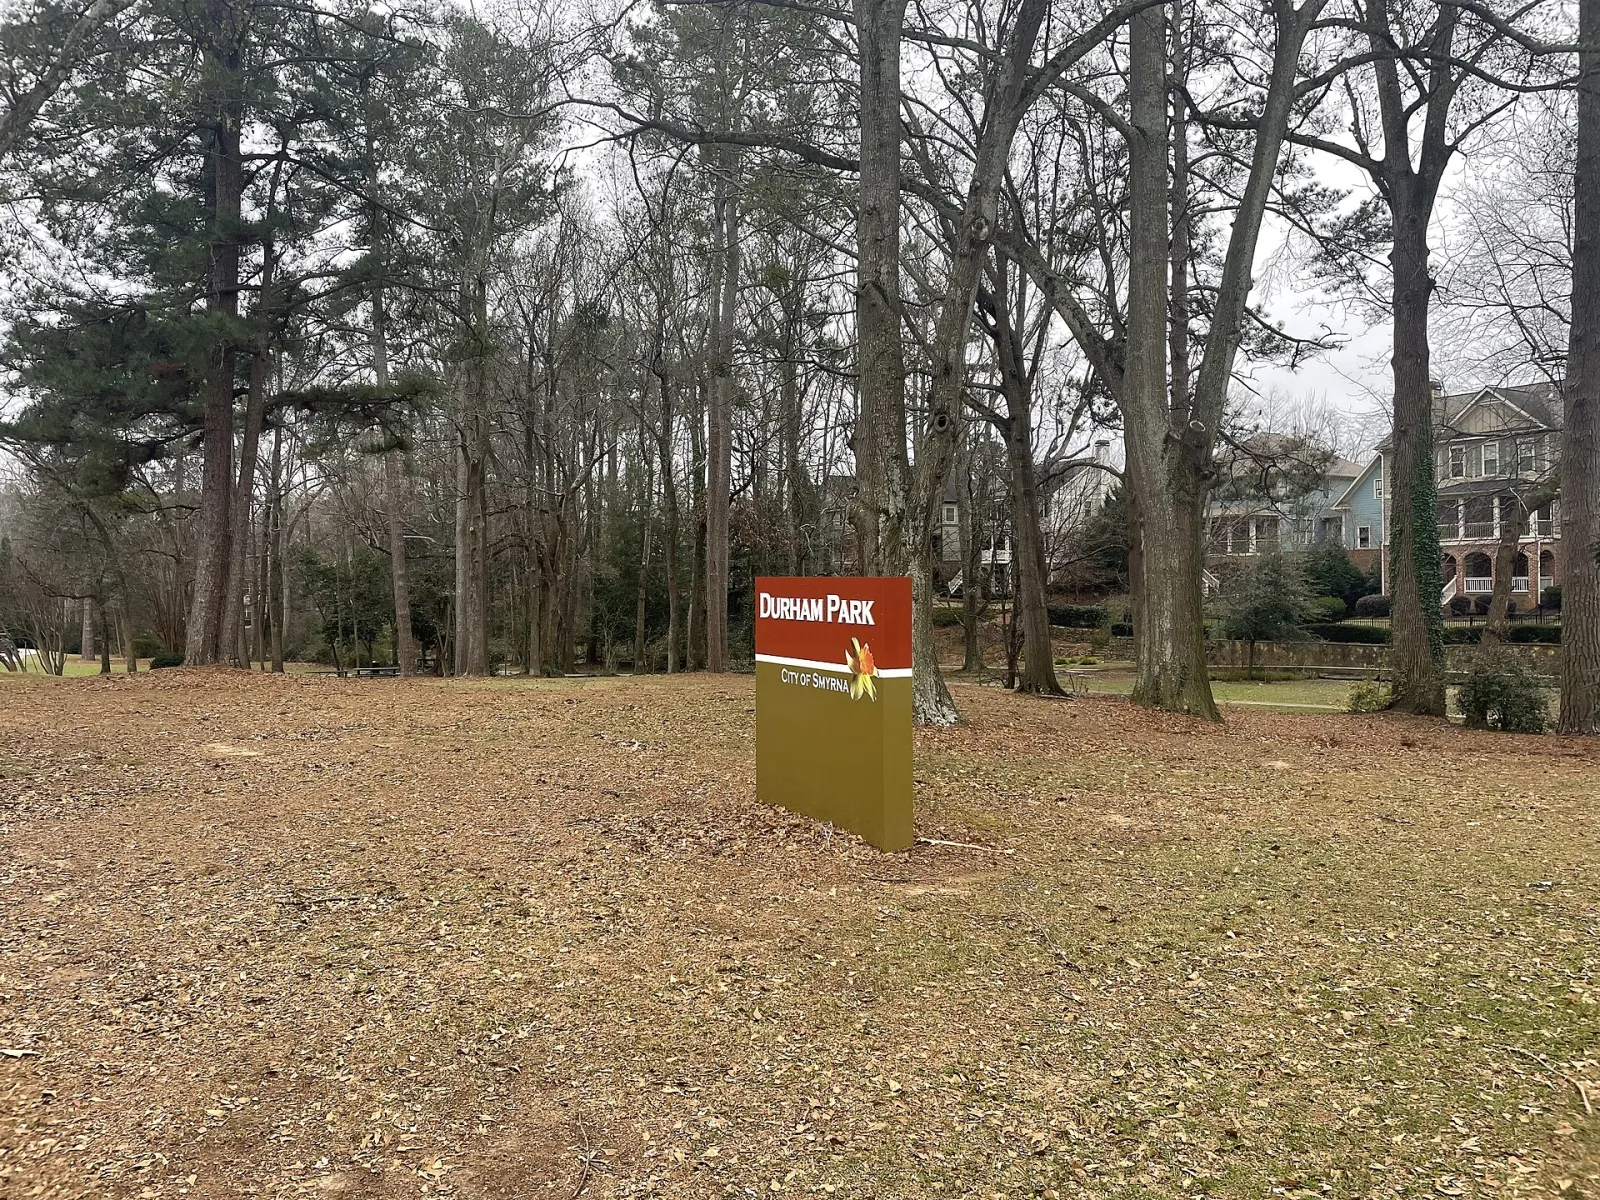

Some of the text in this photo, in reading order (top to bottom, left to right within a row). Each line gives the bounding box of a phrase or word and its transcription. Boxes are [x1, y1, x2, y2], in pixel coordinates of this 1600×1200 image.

[759, 592, 875, 625] DURHAM PARK
[781, 668, 849, 693] CITY OF SMYRNA
